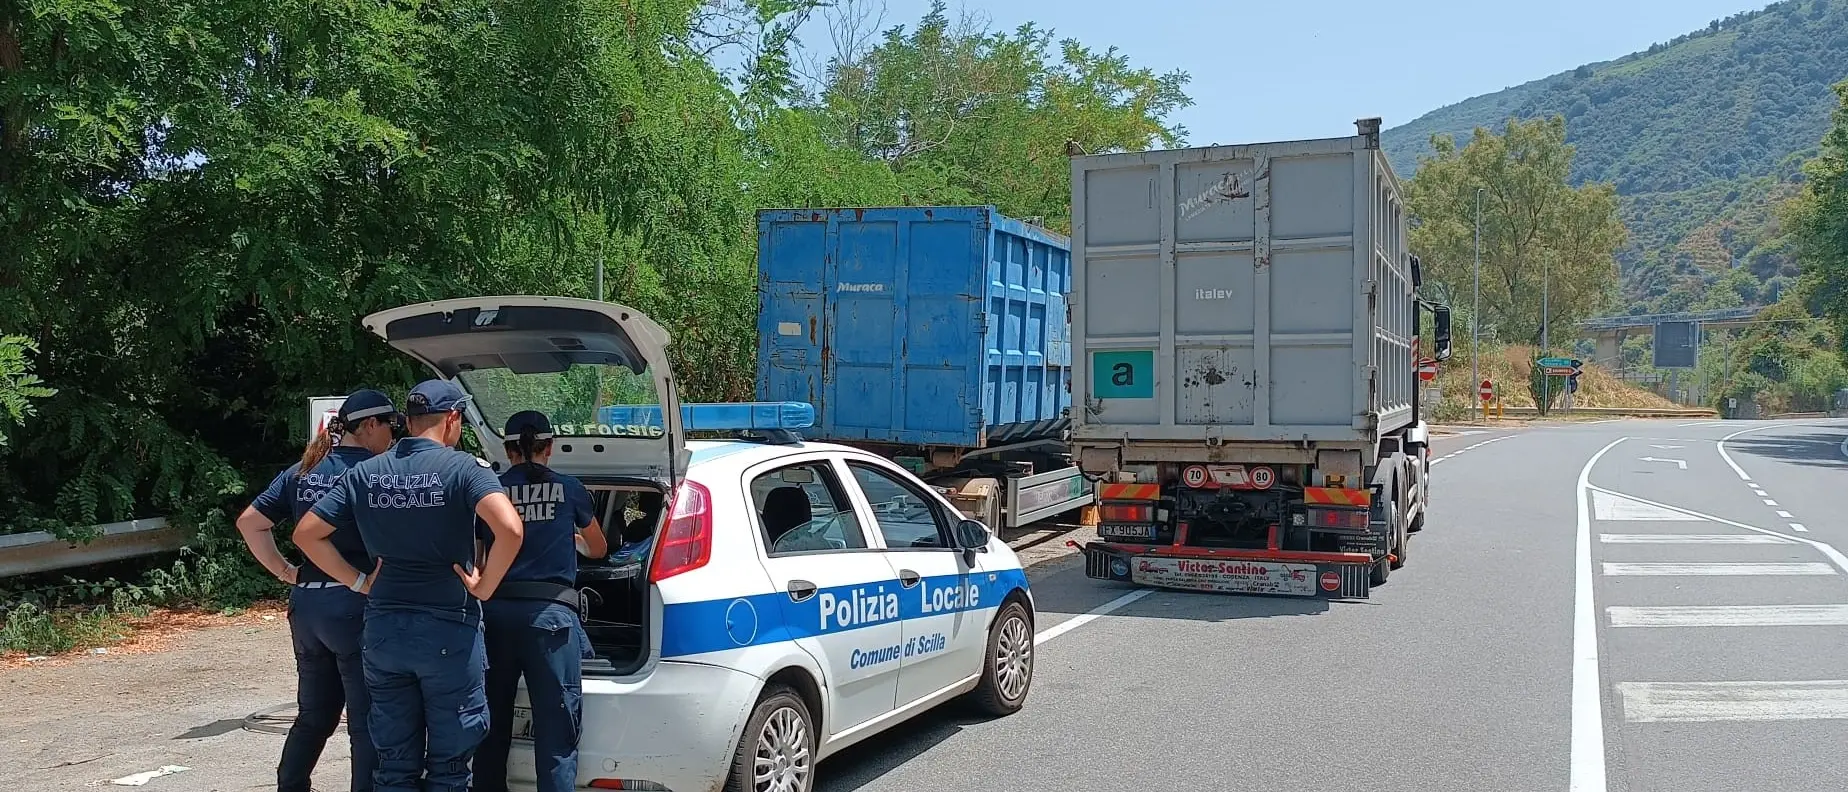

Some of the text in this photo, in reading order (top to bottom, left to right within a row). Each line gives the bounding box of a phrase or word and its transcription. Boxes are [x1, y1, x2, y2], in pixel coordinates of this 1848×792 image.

[1179, 179, 1227, 217] Murac
[836, 282, 883, 293] Muraca
[1112, 362, 1134, 386] a
[368, 472, 443, 489] POLIZIA
[1190, 470, 1202, 480] 70
[1255, 471, 1268, 482] 80
[367, 490, 445, 509] LOCALE
[504, 482, 565, 504] LIZIA
[515, 502, 556, 522] CALE
[1177, 559, 1267, 576] Victor Santino
[819, 578, 979, 630] Polizia Locale
[850, 631, 946, 670] Comune di Scilla
